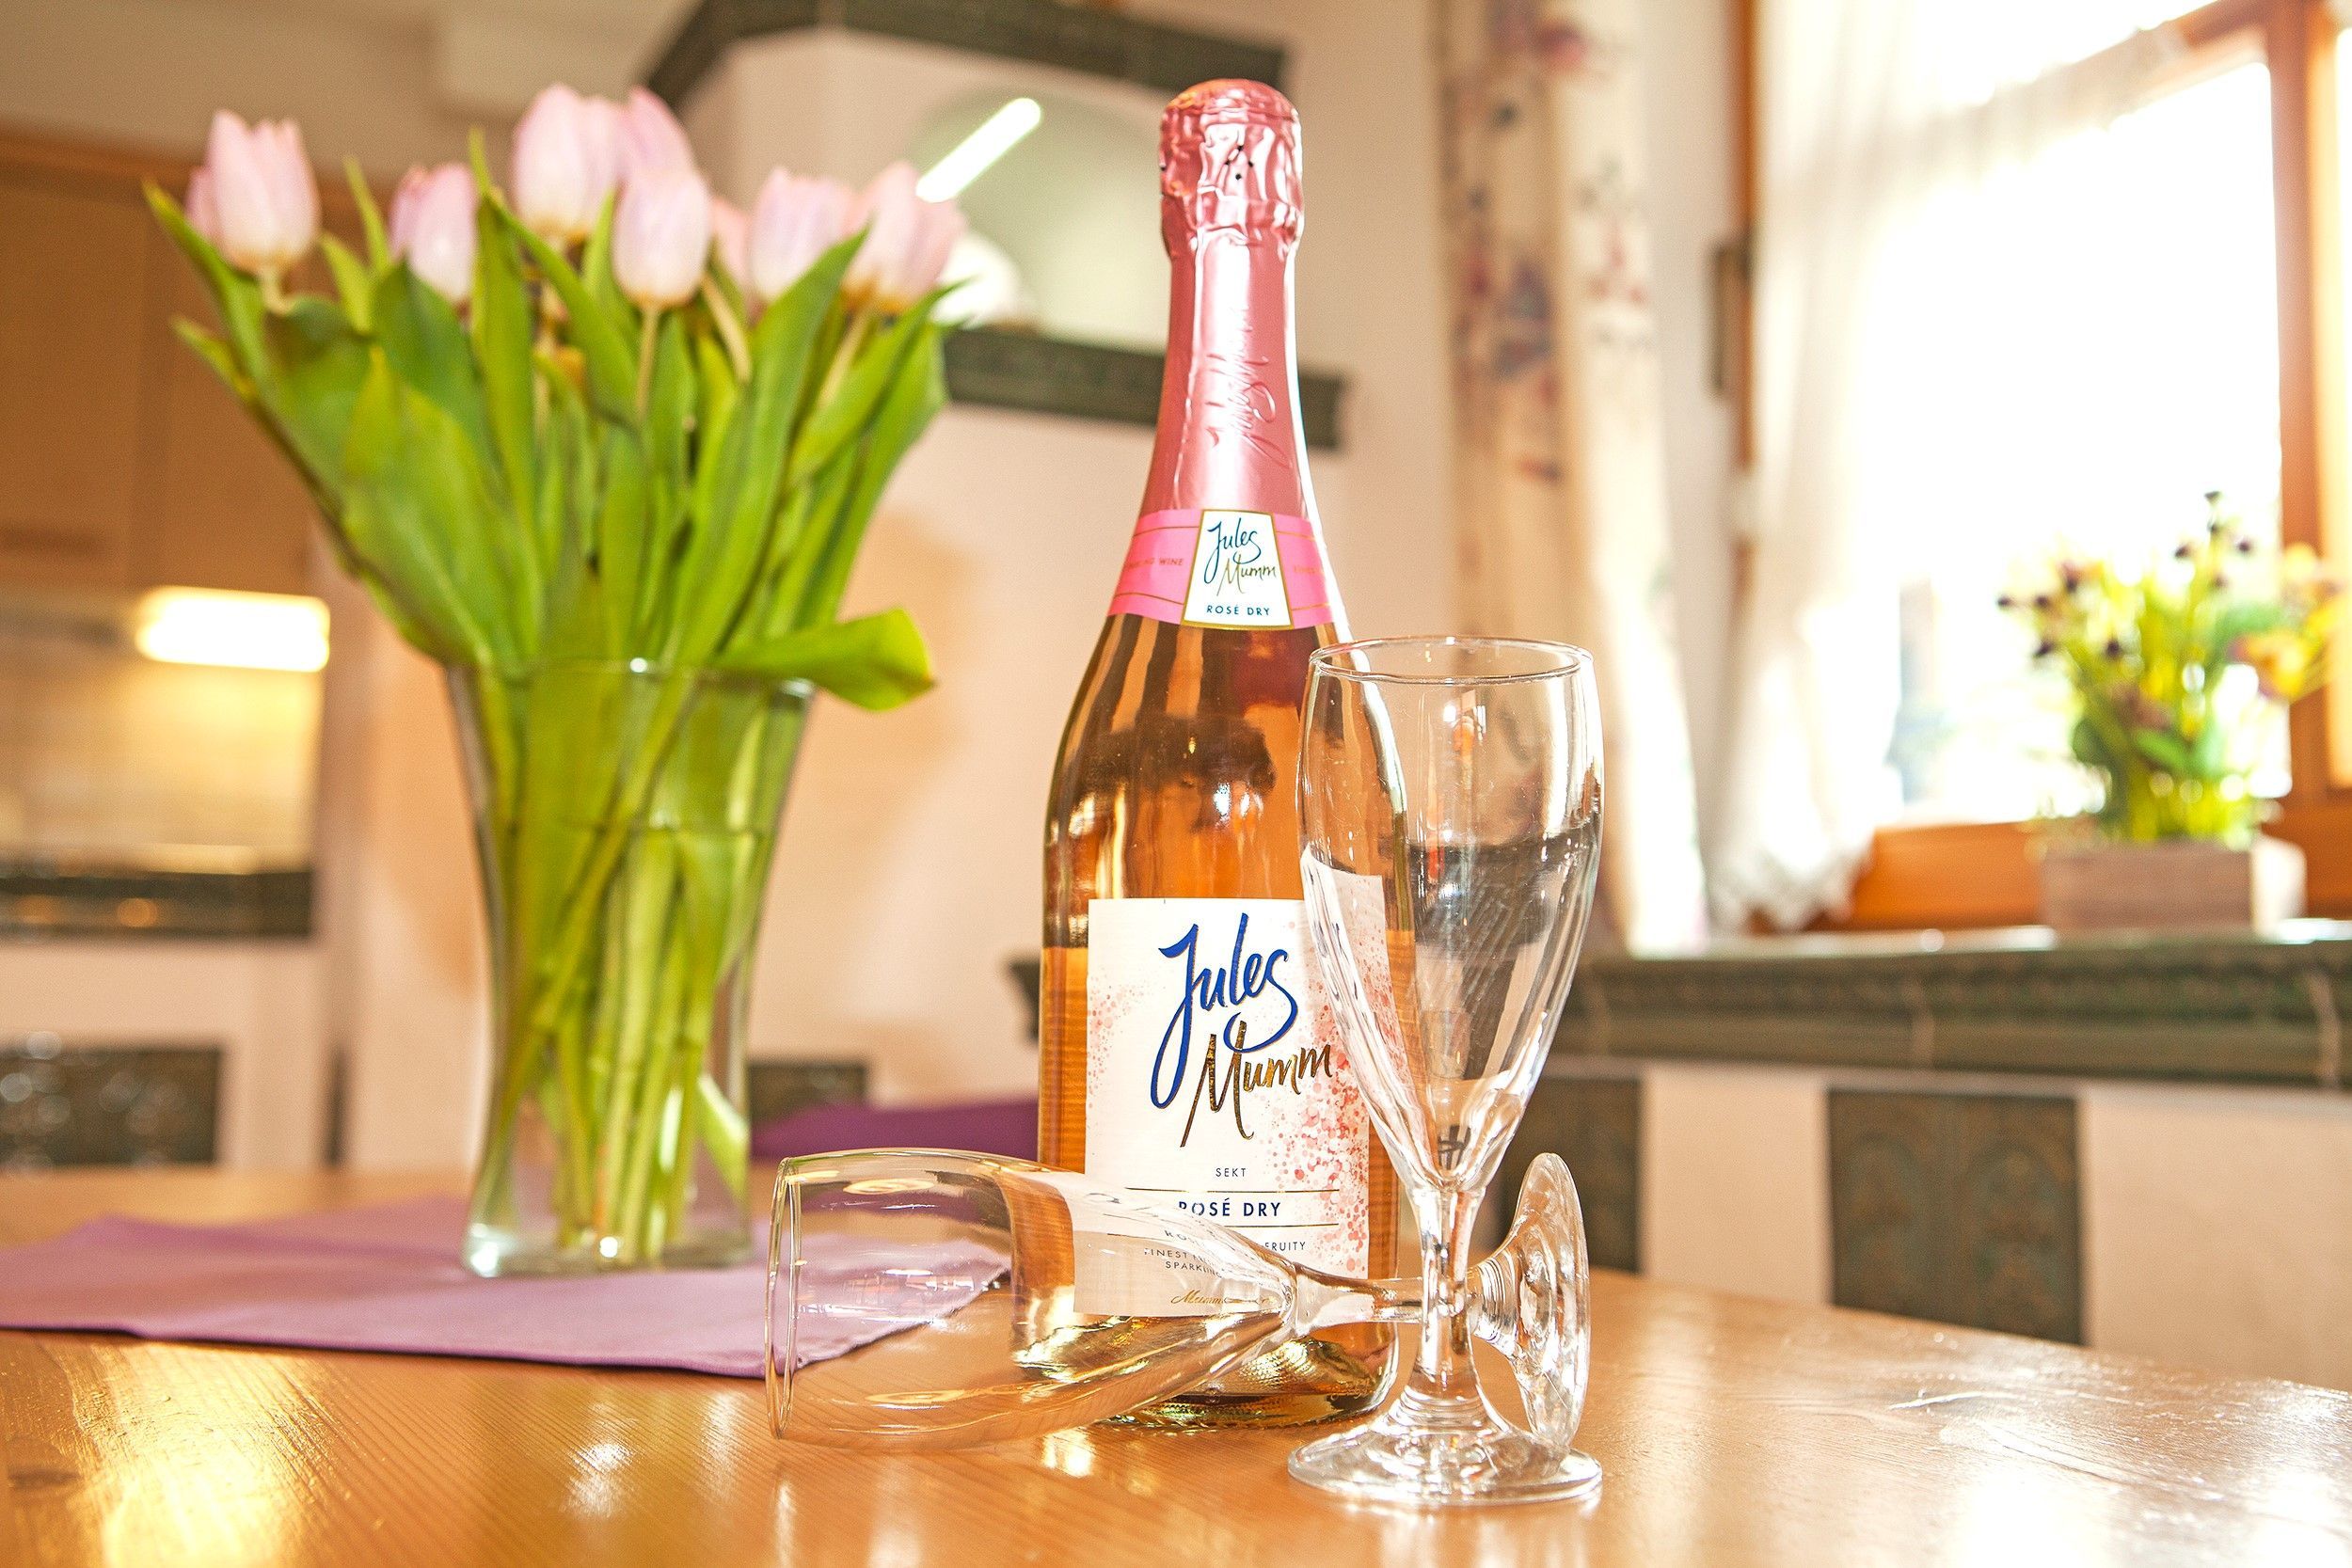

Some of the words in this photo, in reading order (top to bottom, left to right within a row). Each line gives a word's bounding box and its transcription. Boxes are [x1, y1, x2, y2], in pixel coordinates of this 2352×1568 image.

[1203, 517, 1262, 584] Jules
[1216, 553, 1279, 596] Mumm
[1206, 604, 1239, 615] ROSÉ
[1247, 607, 1270, 616] DRY
[1151, 912, 1298, 1109] Jules
[1180, 1021, 1333, 1148] Mumm
[1216, 1167, 1247, 1178] SEKT
[1243, 1202, 1281, 1216] DRY
